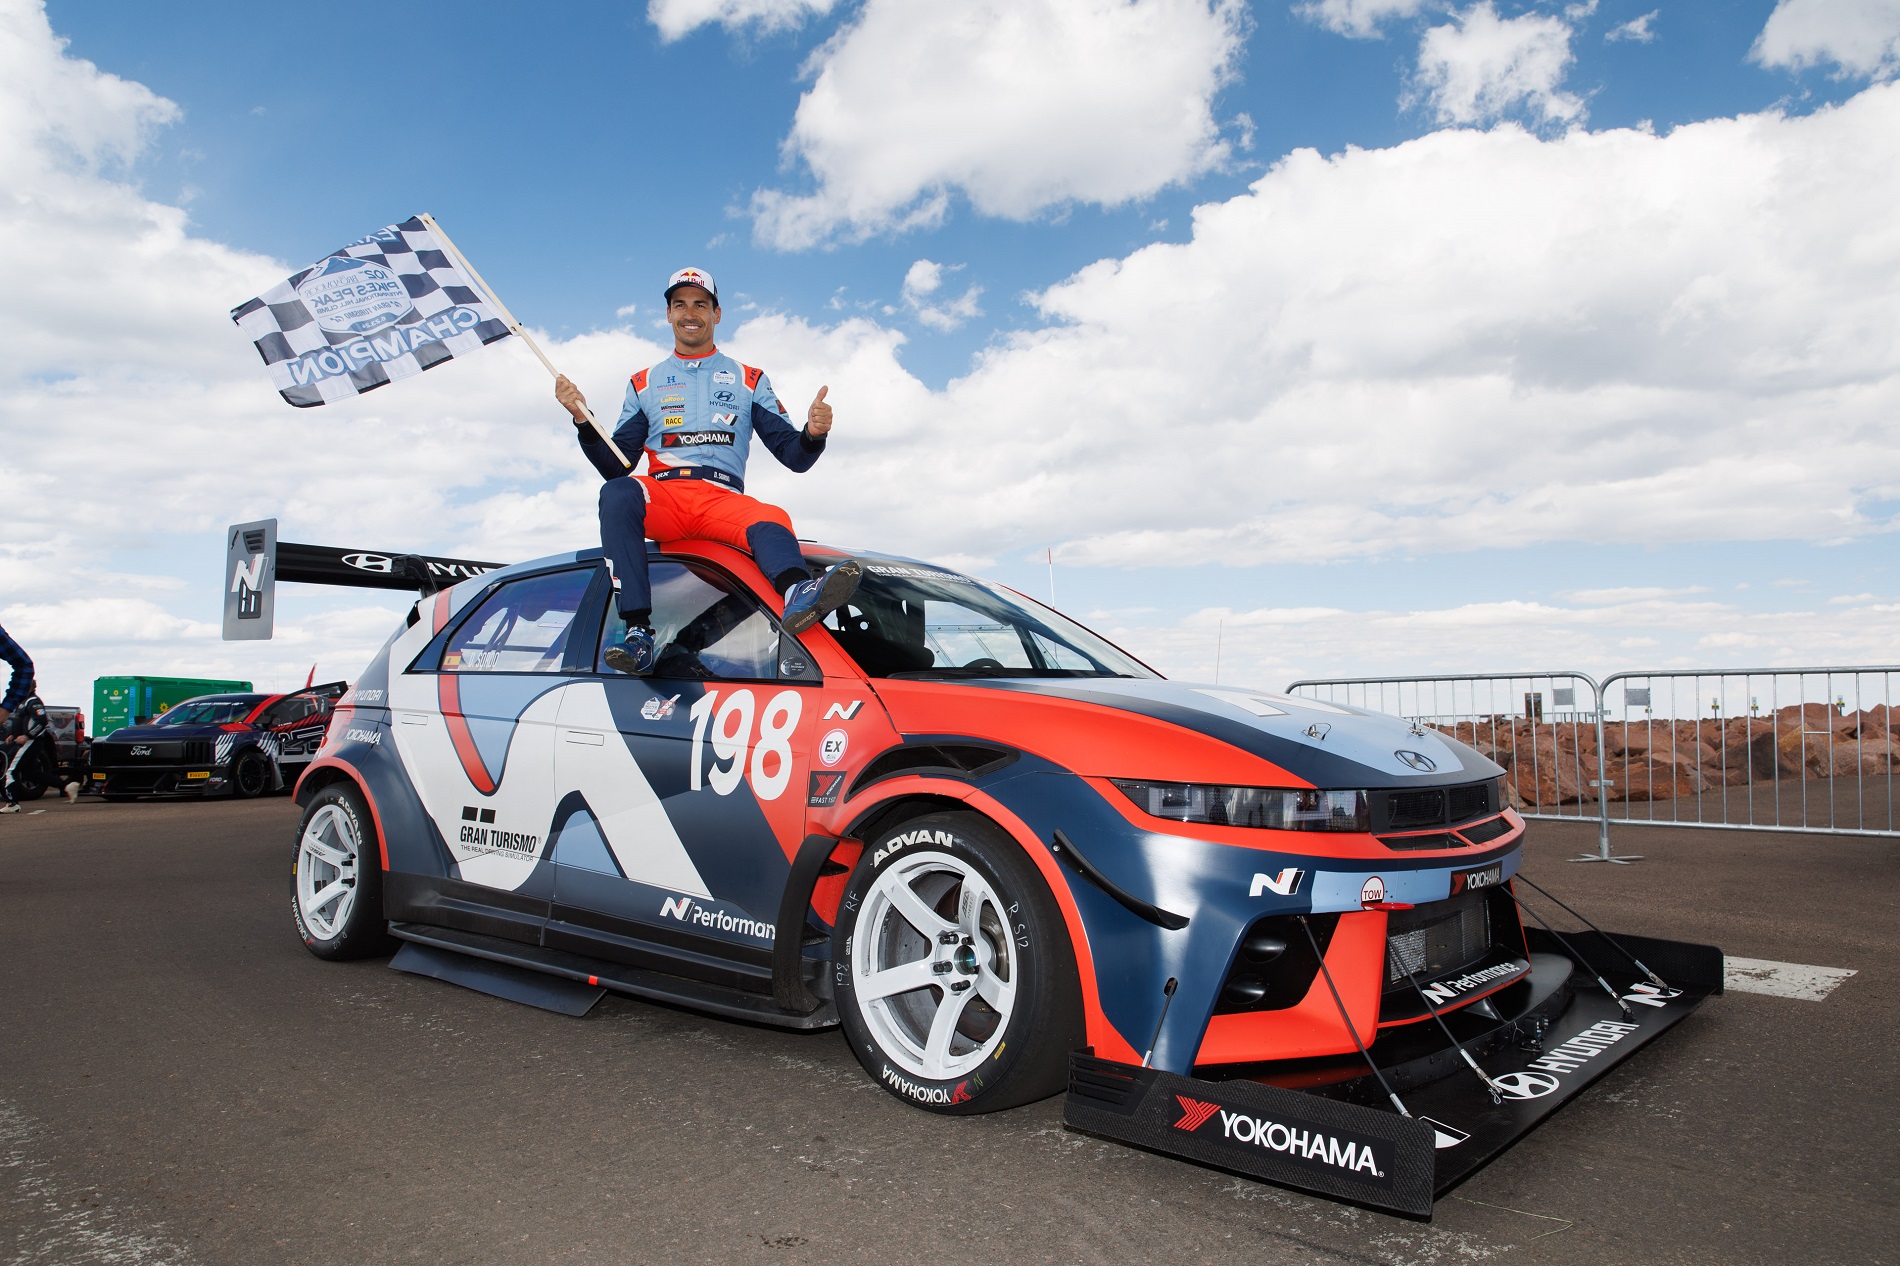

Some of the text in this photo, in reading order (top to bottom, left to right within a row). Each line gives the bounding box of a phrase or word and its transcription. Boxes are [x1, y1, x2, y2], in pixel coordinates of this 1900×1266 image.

[710, 400, 740, 410] HYUNDAI
[678, 434, 732, 444] YOKOHAMA
[867, 566, 911, 575] GRAN
[354, 690, 383, 700] HYUNDAI
[130, 745, 152, 756] Ford
[690, 688, 802, 800] 198
[825, 741, 842, 752] EX
[337, 796, 363, 846] ADVAN
[460, 826, 537, 853] GRAN TURISMO
[872, 830, 953, 868] ADVAN
[505, 852, 533, 862] SIMULATOR
[1466, 868, 1500, 890] YOKOHAMA
[1364, 890, 1382, 899] TOW
[836, 963, 850, 986] 198
[1447, 962, 1520, 991] Performance
[1527, 1020, 1640, 1073] HYUNDAI
[882, 1064, 951, 1103] YOKOHAMA
[1220, 1110, 1378, 1177] YOKOHAMA
